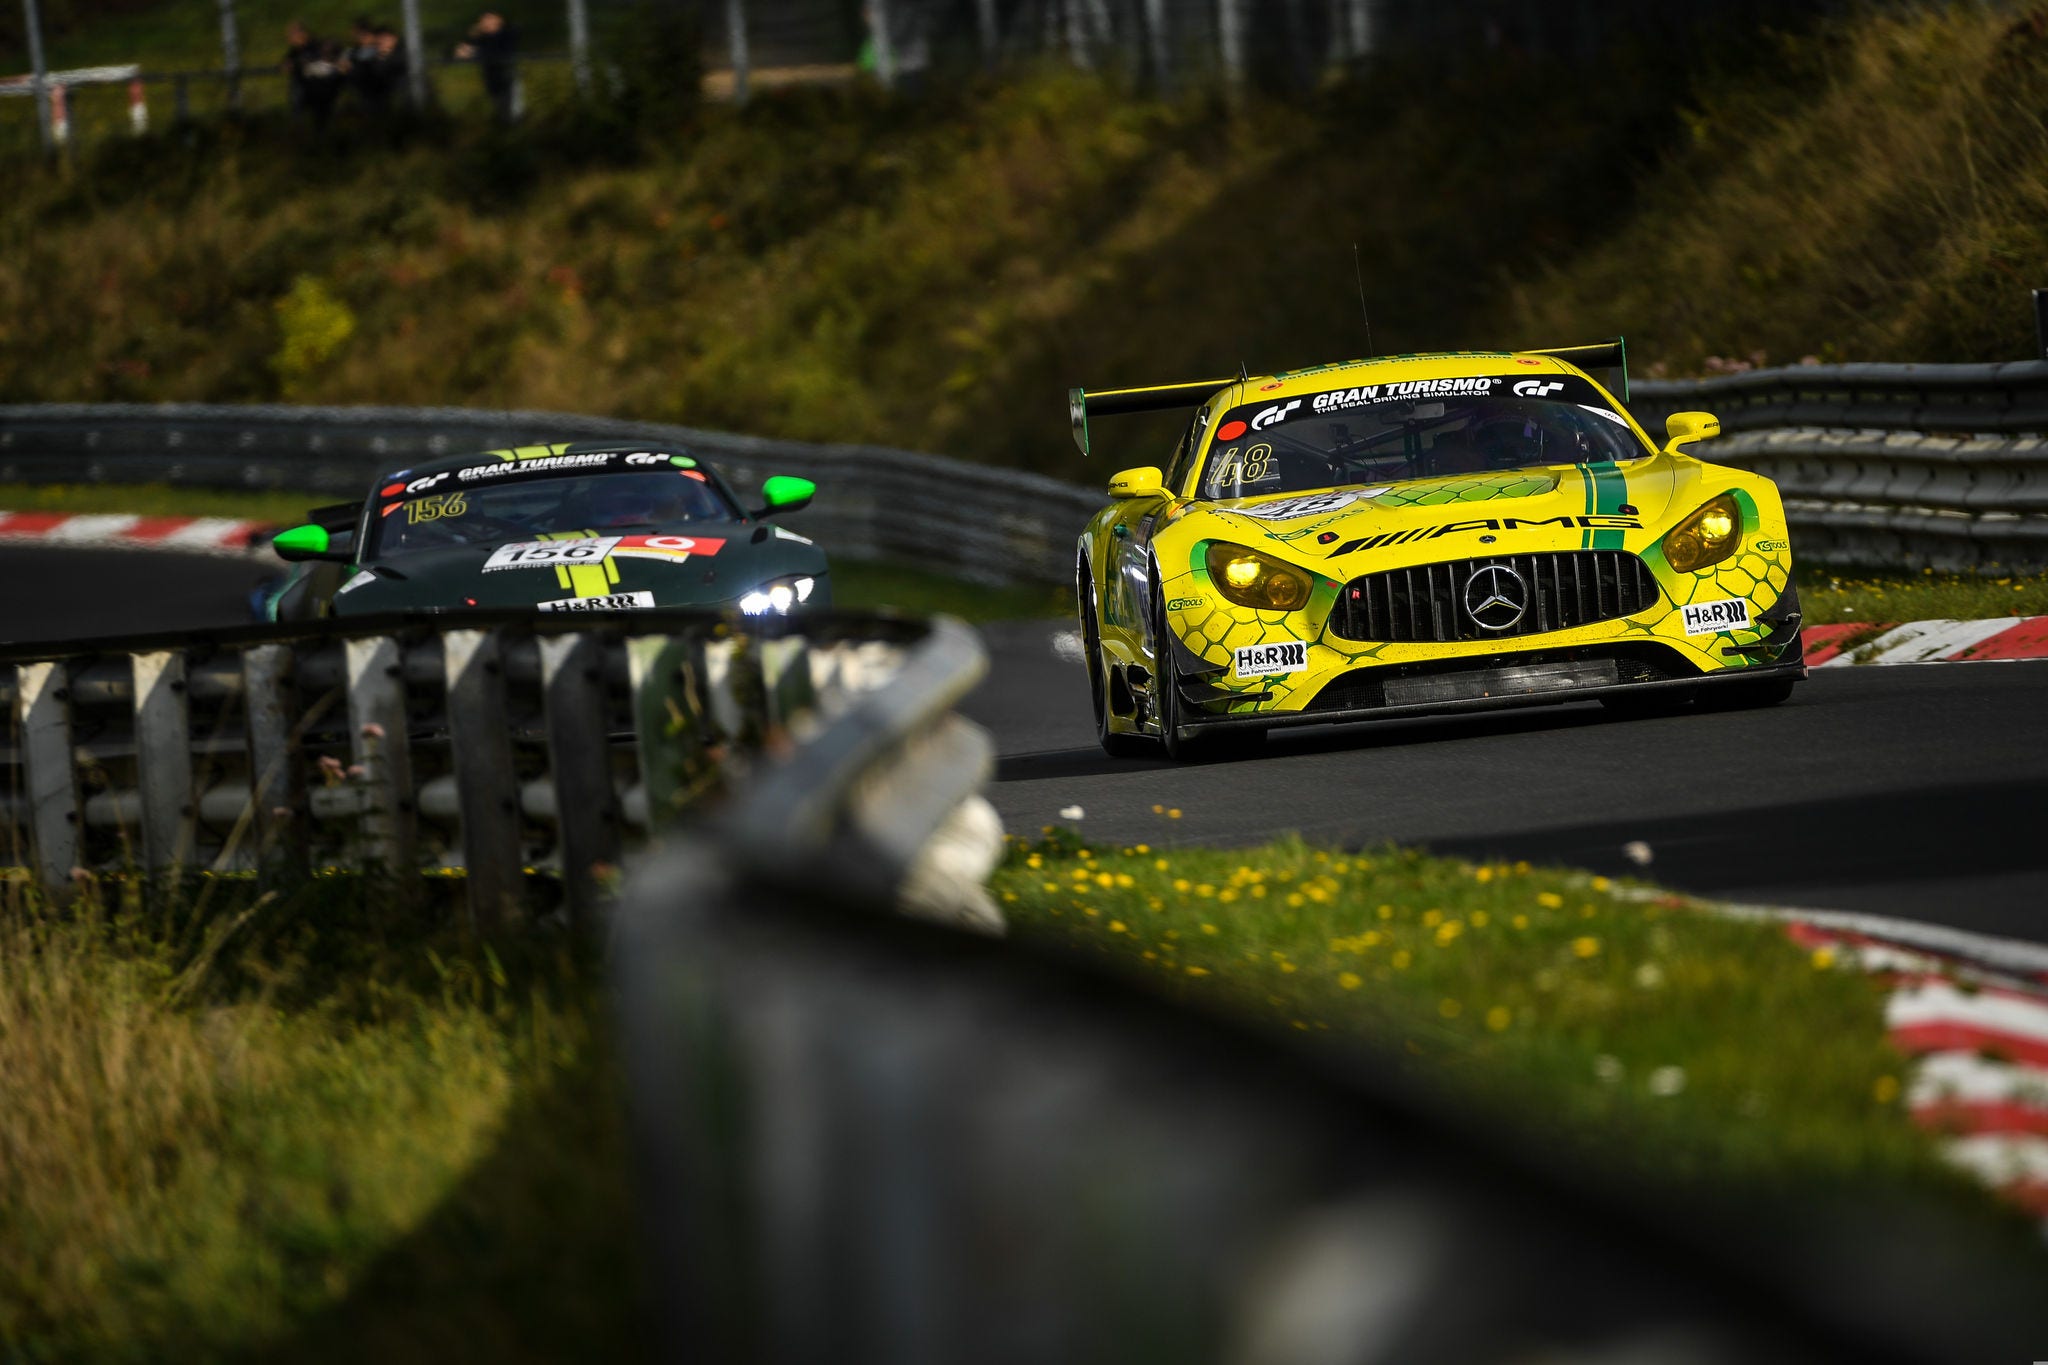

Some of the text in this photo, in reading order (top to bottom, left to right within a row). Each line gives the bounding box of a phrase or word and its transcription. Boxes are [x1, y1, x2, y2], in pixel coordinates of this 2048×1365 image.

[1312, 385, 1379, 409] GRAN
[1314, 390, 1490, 414] THE REAL DRIVING SIMULATOR
[457, 462, 514, 478] GRAN
[1210, 443, 1272, 487] 48
[403, 491, 467, 525] 156
[1427, 516, 1644, 539] AMG
[504, 545, 598, 561] 156
[1685, 604, 1726, 625] H&R
[1238, 647, 1279, 668] H&R
